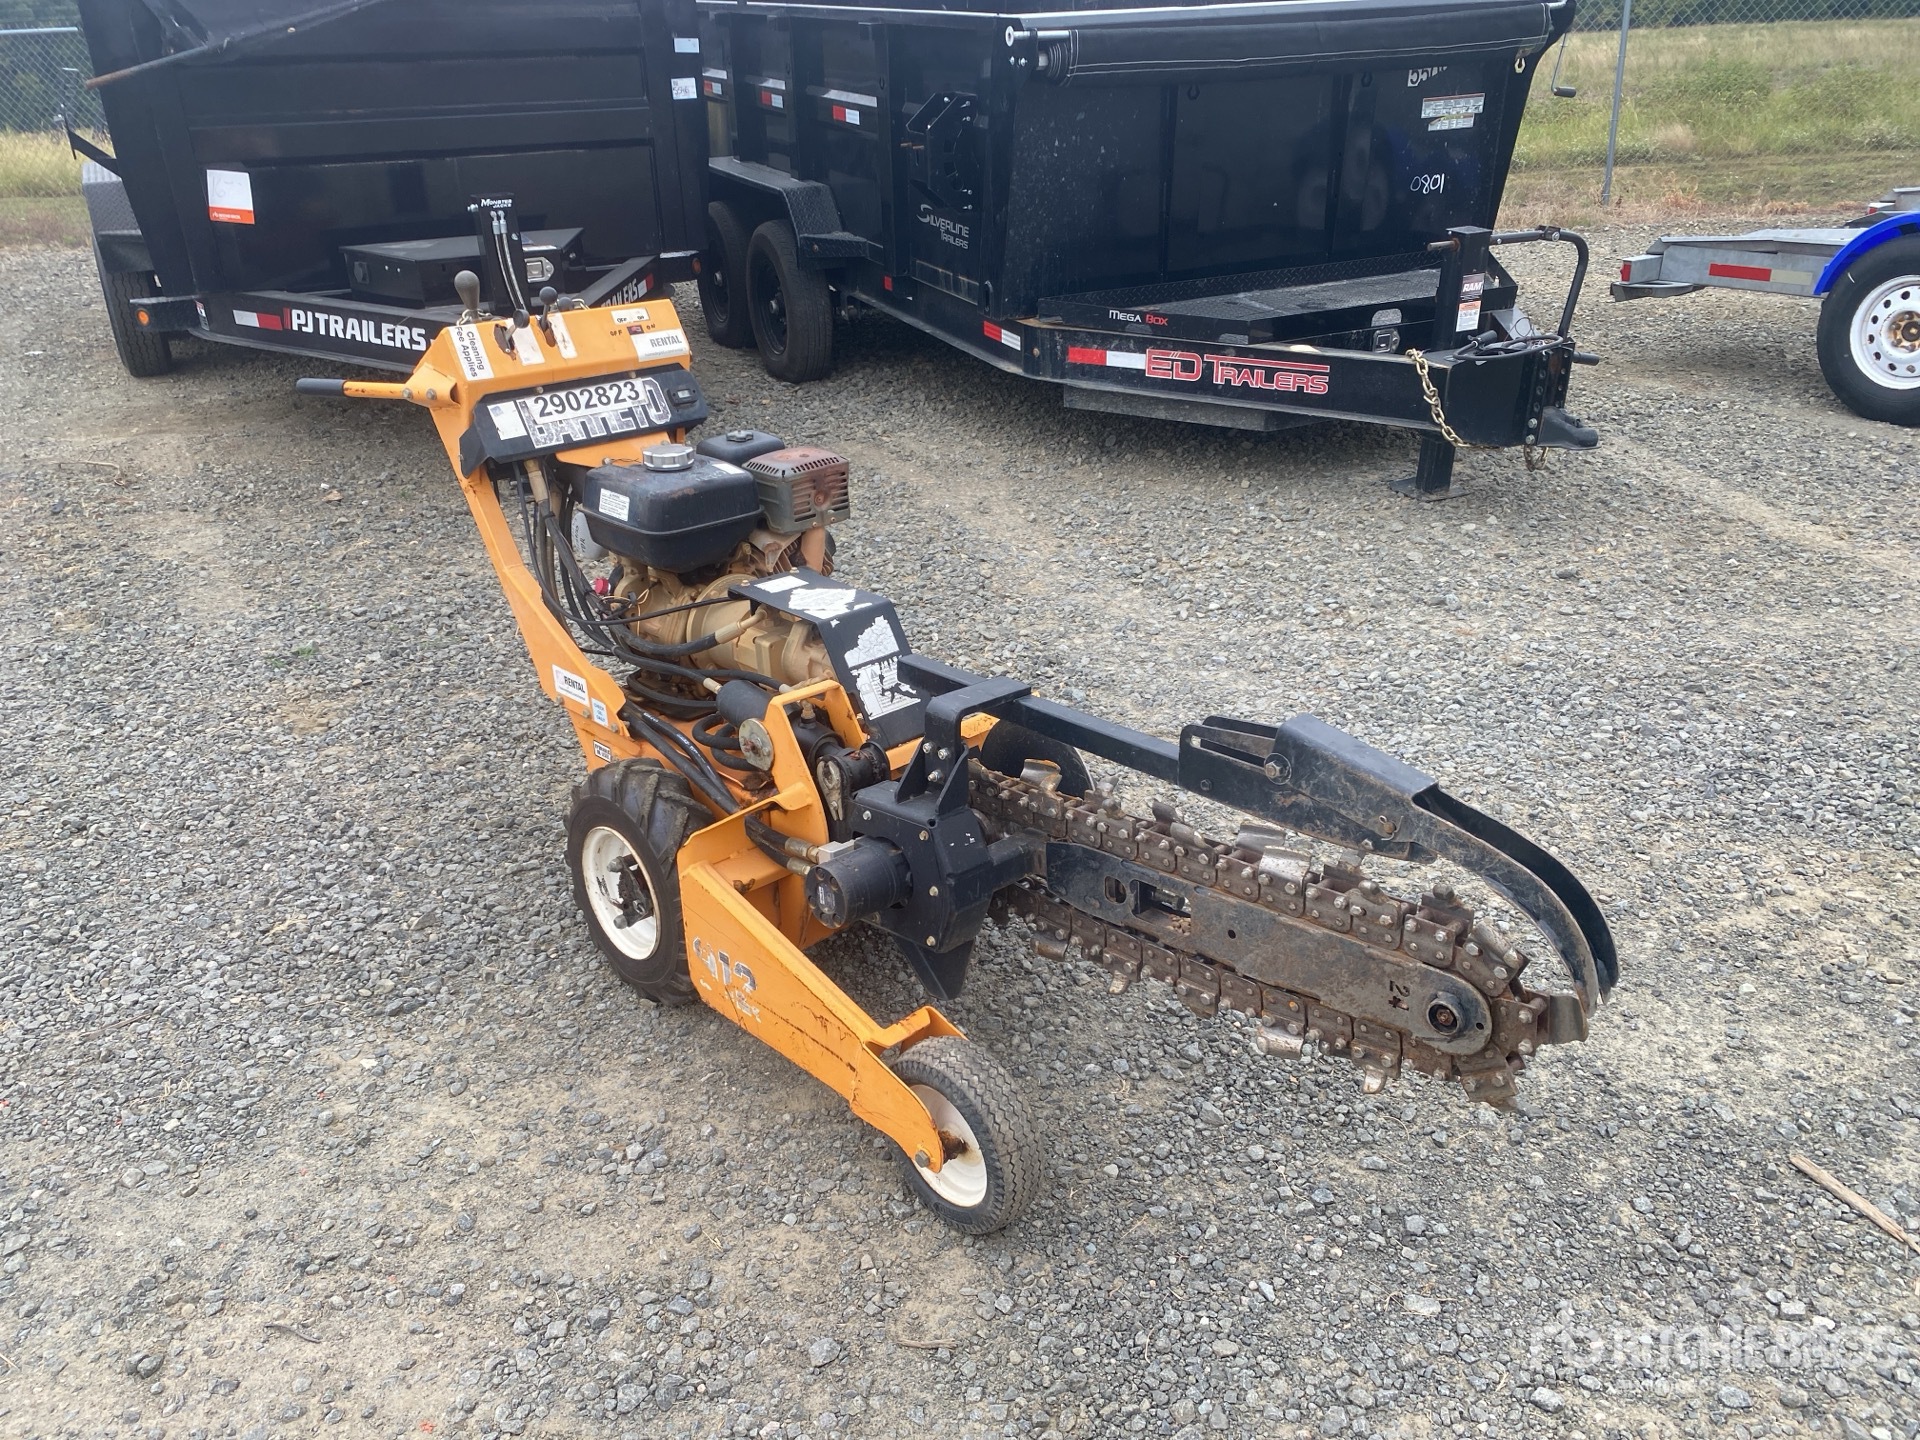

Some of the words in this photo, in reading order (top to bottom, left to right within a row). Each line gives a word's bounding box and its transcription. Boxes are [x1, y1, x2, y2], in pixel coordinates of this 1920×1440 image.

[1410, 173, 1445, 194] 0801
[481, 198, 512, 207] MONSTER
[916, 203, 970, 238] SILVERLINE
[940, 228, 969, 250] TRAILERS
[291, 308, 314, 333] PJ
[314, 312, 427, 351] TRAILERS
[1109, 309, 1142, 323] MEGA
[454, 326, 465, 342] Fee
[461, 344, 478, 378] Applies
[466, 331, 485, 371] Cleaning
[649, 335, 682, 348] RENTAL
[1145, 348, 1202, 382] ED
[1204, 353, 1330, 395] TRAILERS
[533, 380, 640, 419] 2902823
[564, 675, 586, 694] RENTAL
